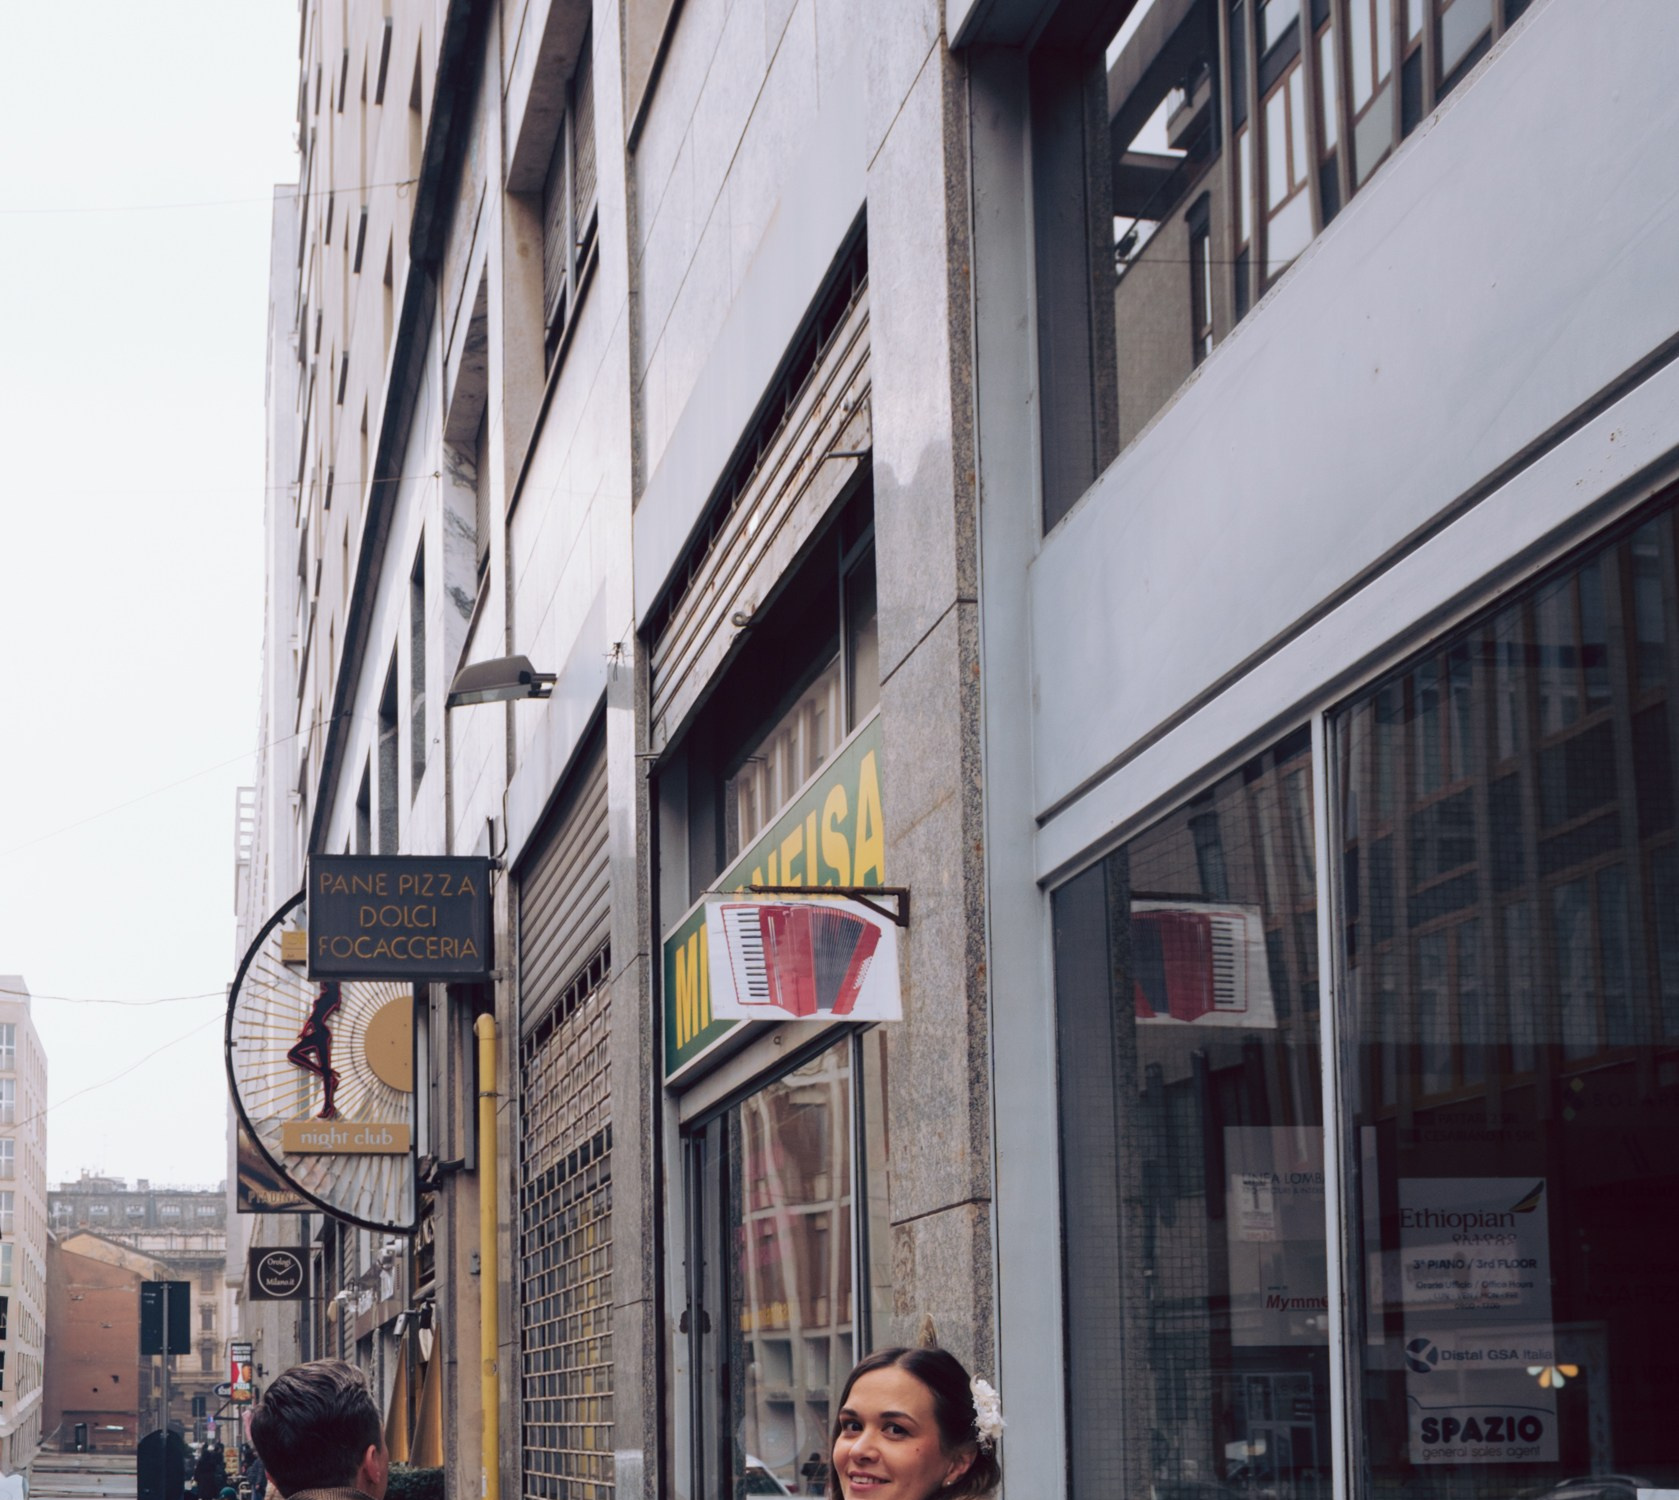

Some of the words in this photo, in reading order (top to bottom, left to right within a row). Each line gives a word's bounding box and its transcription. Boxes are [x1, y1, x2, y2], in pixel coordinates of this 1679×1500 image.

[318, 872, 389, 896] PANE
[399, 873, 477, 897] PIZZA
[359, 904, 438, 928] DOLCI
[318, 935, 479, 959] FOCACCERIA
[300, 1126, 350, 1149] night
[353, 1127, 394, 1146] club
[1284, 1172, 1326, 1185] LOMB
[1400, 1208, 1516, 1233] Ethiopian
[266, 1257, 292, 1268] Orologi
[1427, 1259, 1465, 1270] PIANO
[1476, 1259, 1496, 1270] 3rd
[1497, 1259, 1538, 1270] FLOOR
[265, 1277, 296, 1286] Milano.it
[1481, 1280, 1507, 1290] Office
[1508, 1281, 1534, 1289] Hours
[1441, 1349, 1483, 1361] Distal
[1487, 1349, 1519, 1361] GSA
[1523, 1349, 1553, 1360] Italia
[1420, 1415, 1544, 1445] SPAZIO
[1422, 1446, 1468, 1460] general
[1471, 1445, 1503, 1457] sales
[1505, 1445, 1541, 1459] agent
